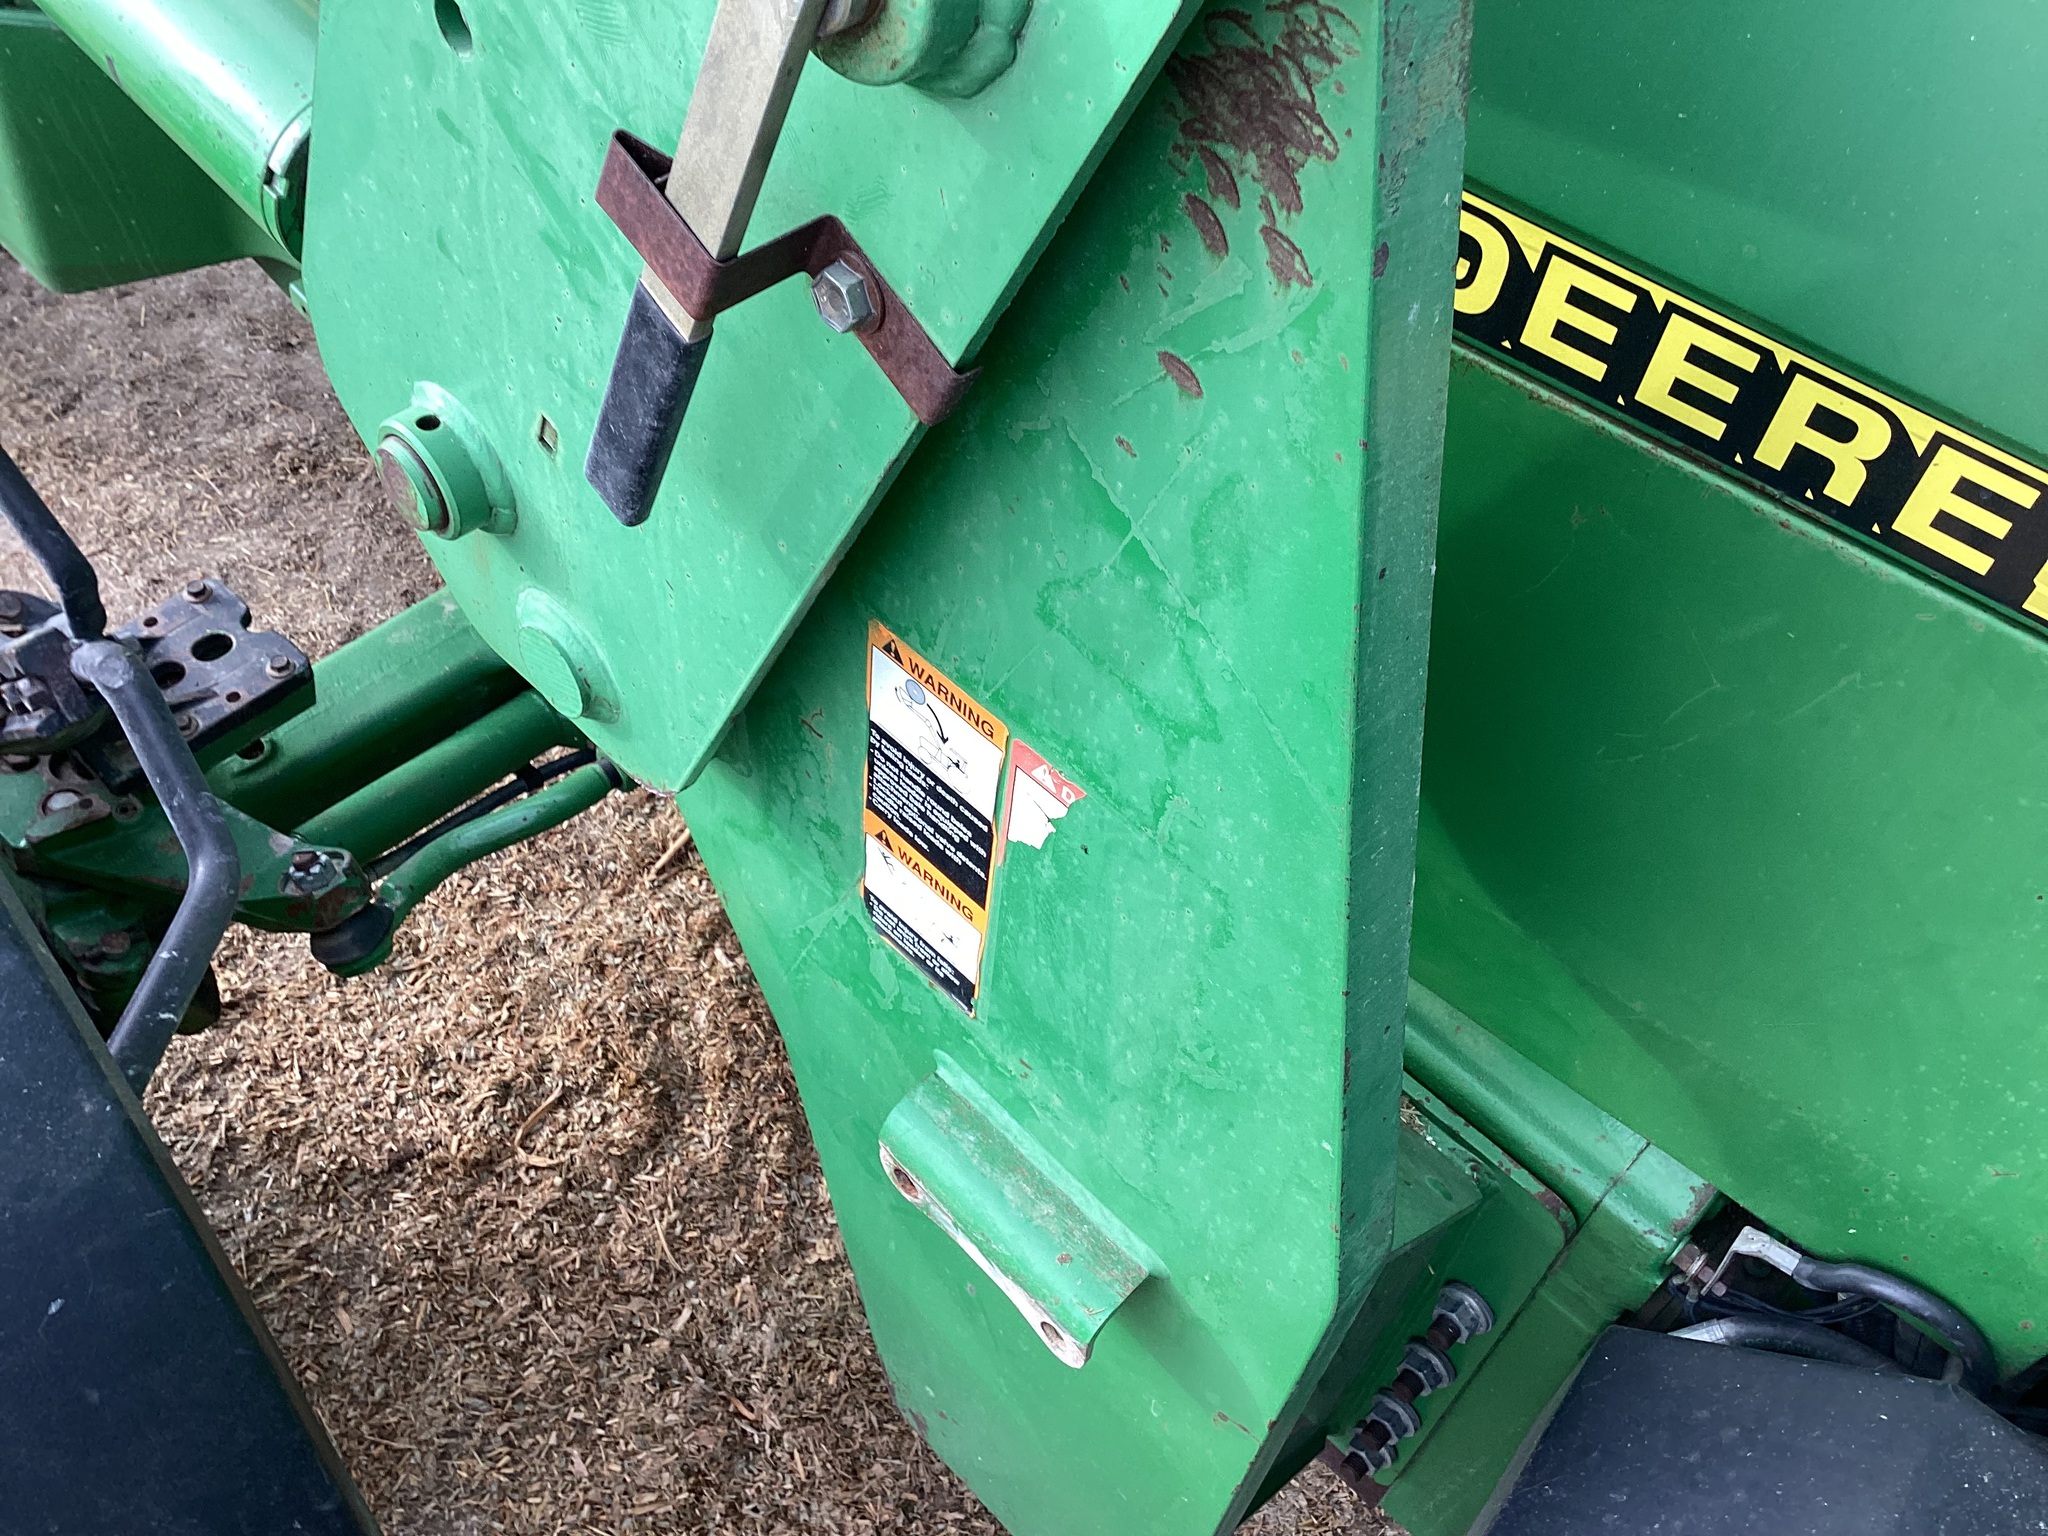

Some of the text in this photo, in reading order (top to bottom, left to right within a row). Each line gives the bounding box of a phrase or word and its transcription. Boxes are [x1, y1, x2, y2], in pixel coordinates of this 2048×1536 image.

[908, 657, 995, 739] WARNING
[881, 745, 904, 770] falling
[881, 738, 902, 759] avoid
[903, 756, 925, 780] injury
[936, 785, 958, 807] death
[959, 805, 988, 833] caused
[872, 798, 892, 819] Carry
[893, 816, 913, 838] loads
[873, 778, 903, 807] Lockout
[903, 805, 934, 834] optional
[935, 832, 956, 852] valve
[873, 784, 962, 865] Handle raised loads with
[874, 765, 960, 843] approved bale handling
[874, 758, 898, 782] unless
[899, 778, 923, 802] loader
[933, 809, 969, 842] equipped
[970, 840, 987, 858] with
[900, 771, 926, 798] handle
[926, 795, 950, 819] round
[950, 815, 972, 838] bales
[898, 846, 974, 922] WARNING
